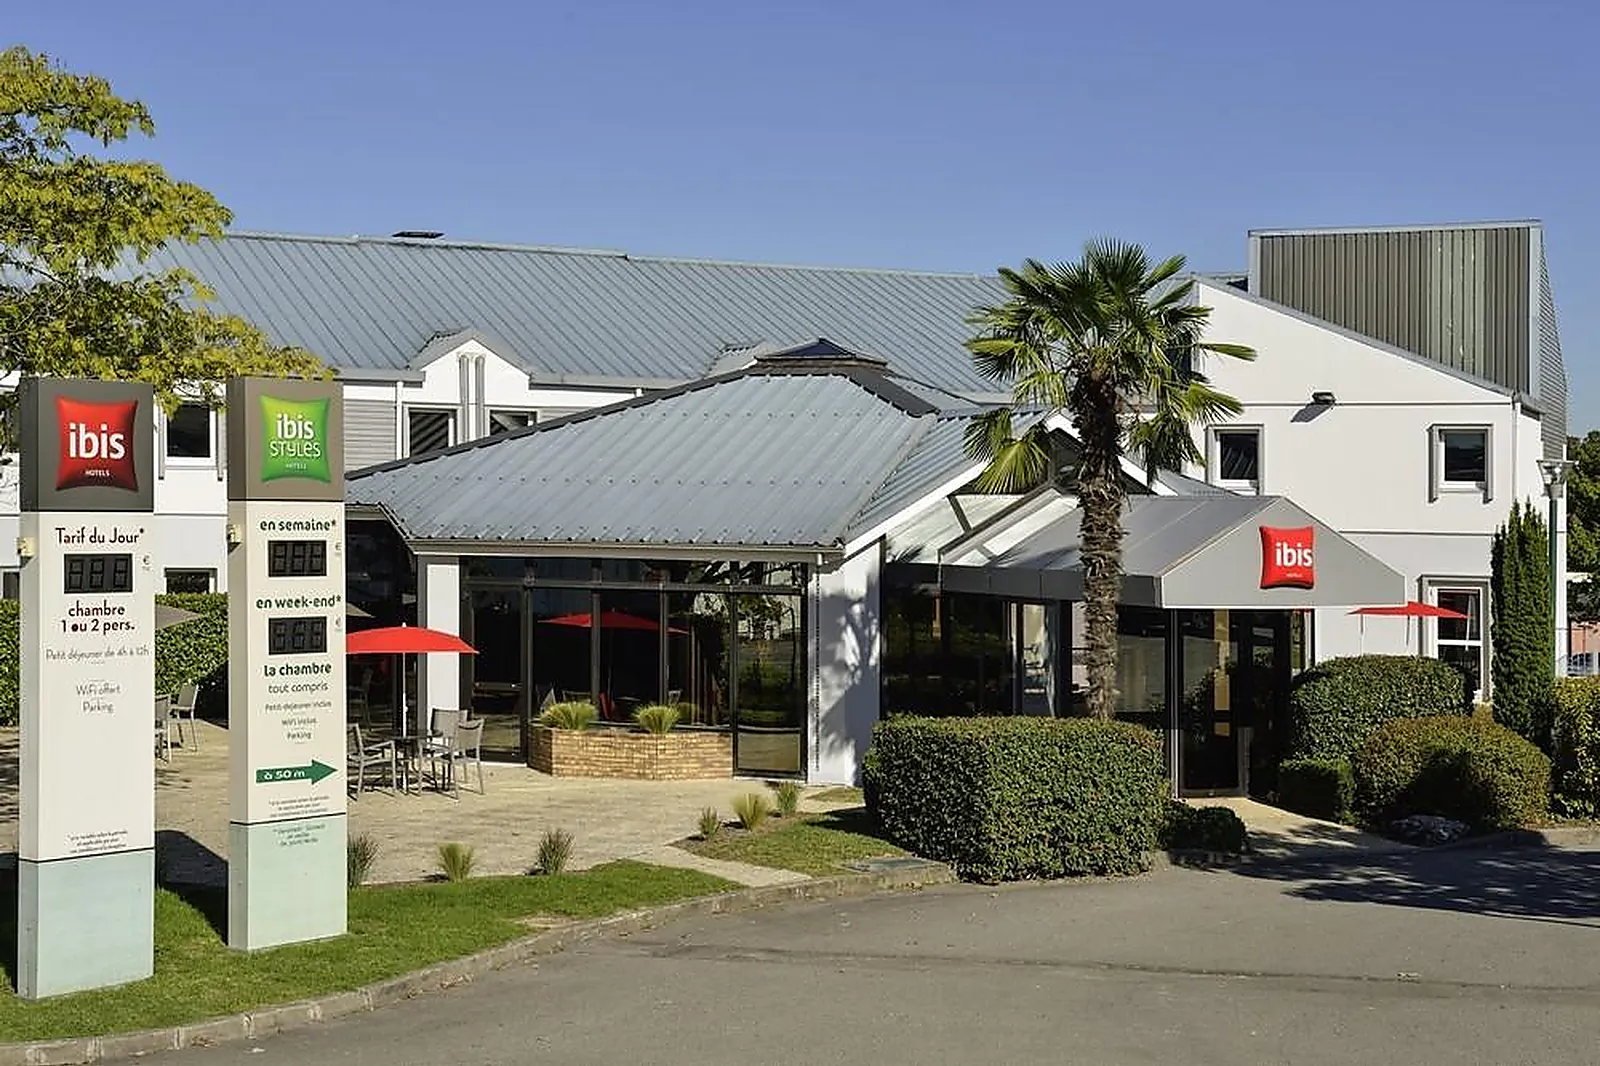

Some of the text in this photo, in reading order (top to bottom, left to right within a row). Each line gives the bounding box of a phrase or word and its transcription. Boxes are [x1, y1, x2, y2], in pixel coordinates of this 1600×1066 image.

[277, 413, 315, 440] ibis
[69, 422, 125, 459] ibis
[85, 468, 110, 477] HOTELS
[260, 520, 276, 531] en
[55, 526, 86, 545] Tarif
[89, 526, 105, 544] du
[1275, 541, 1312, 567] ibis
[68, 599, 125, 617] chambre
[256, 599, 272, 610] en
[61, 618, 135, 635] 1 ou 2 pers.
[264, 662, 331, 677] la chambre
[268, 680, 329, 695] tout compris
[275, 770, 292, 780] 50
[293, 769, 305, 778] m
